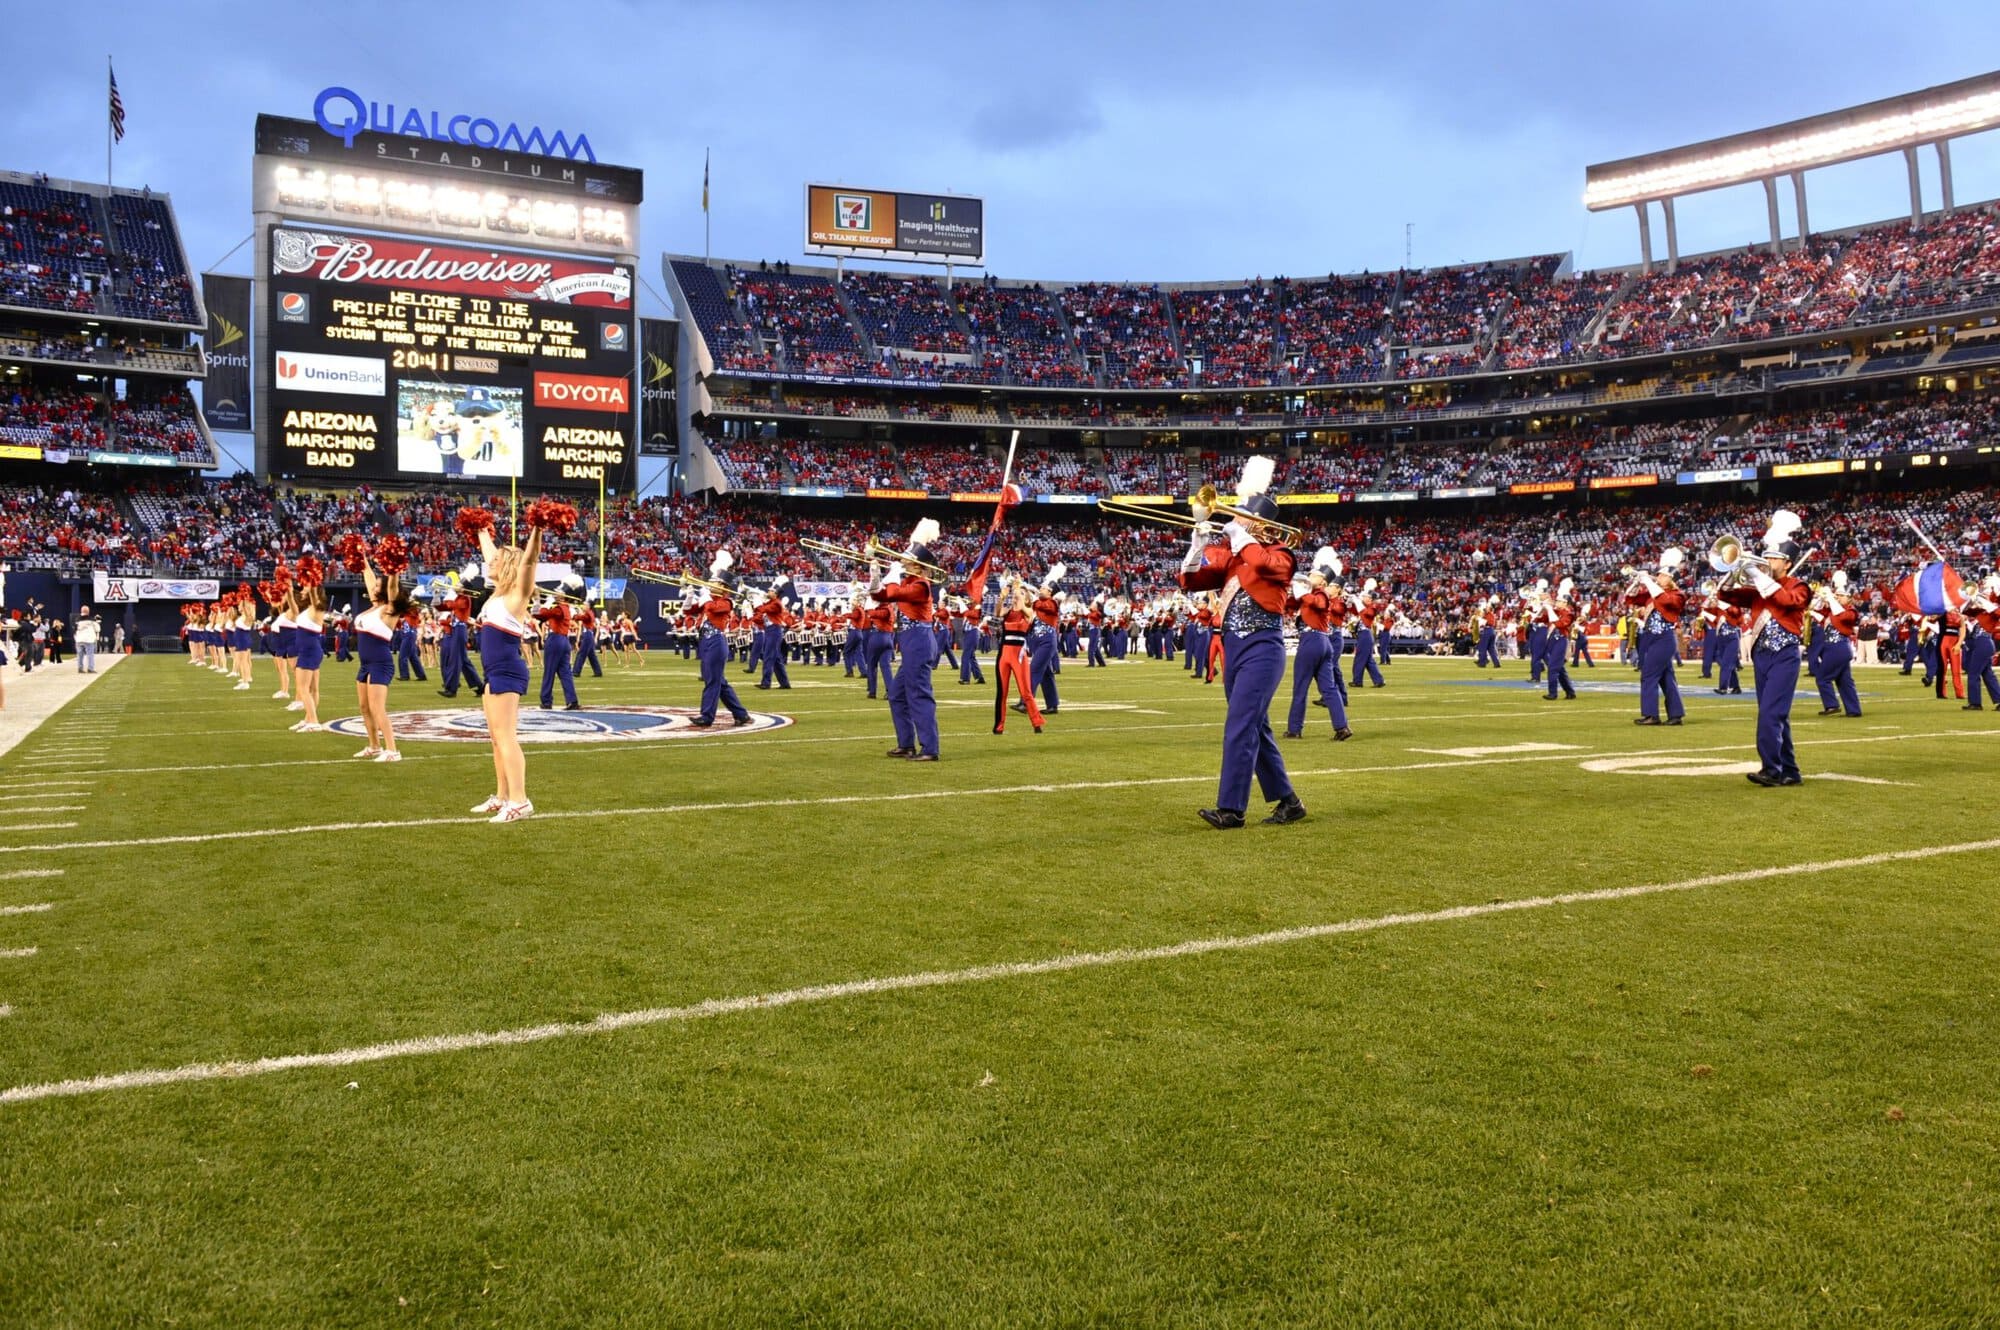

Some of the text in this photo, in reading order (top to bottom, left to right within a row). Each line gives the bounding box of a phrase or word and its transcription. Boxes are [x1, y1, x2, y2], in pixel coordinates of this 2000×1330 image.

[313, 87, 596, 163] QUALCOMM
[377, 142, 576, 181] STADIUM
[899, 219, 979, 234] Imaging Healthcare
[828, 233, 857, 242] THANK
[307, 243, 551, 282] Budweiser
[554, 279, 627, 296] American Lager
[390, 291, 529, 316] WELCOME TO THE
[333, 299, 579, 334] PACIFIC LIFE HOLIDAY BOWL
[342, 315, 572, 345] PRE-GAME SHOW PRESENTED BY THE
[326, 326, 586, 359] SYCUAN BAND OF THE KUMEYAAY NATION
[205, 352, 248, 368] Sprint
[393, 349, 449, 371] 20:41
[305, 367, 383, 384] UnionBank
[539, 382, 624, 404] TOYOTA
[642, 387, 676, 401] Sprint
[283, 411, 378, 433] ARIZONA
[286, 432, 375, 450] MARCHING
[543, 426, 625, 447] ARIZONA
[306, 451, 355, 468] BAND
[545, 447, 623, 464] MARCHING
[562, 464, 605, 480] BAND
[868, 490, 897, 498] WELLS
[1511, 482, 1574, 494] WELLS FARGO
[105, 580, 129, 601] A
